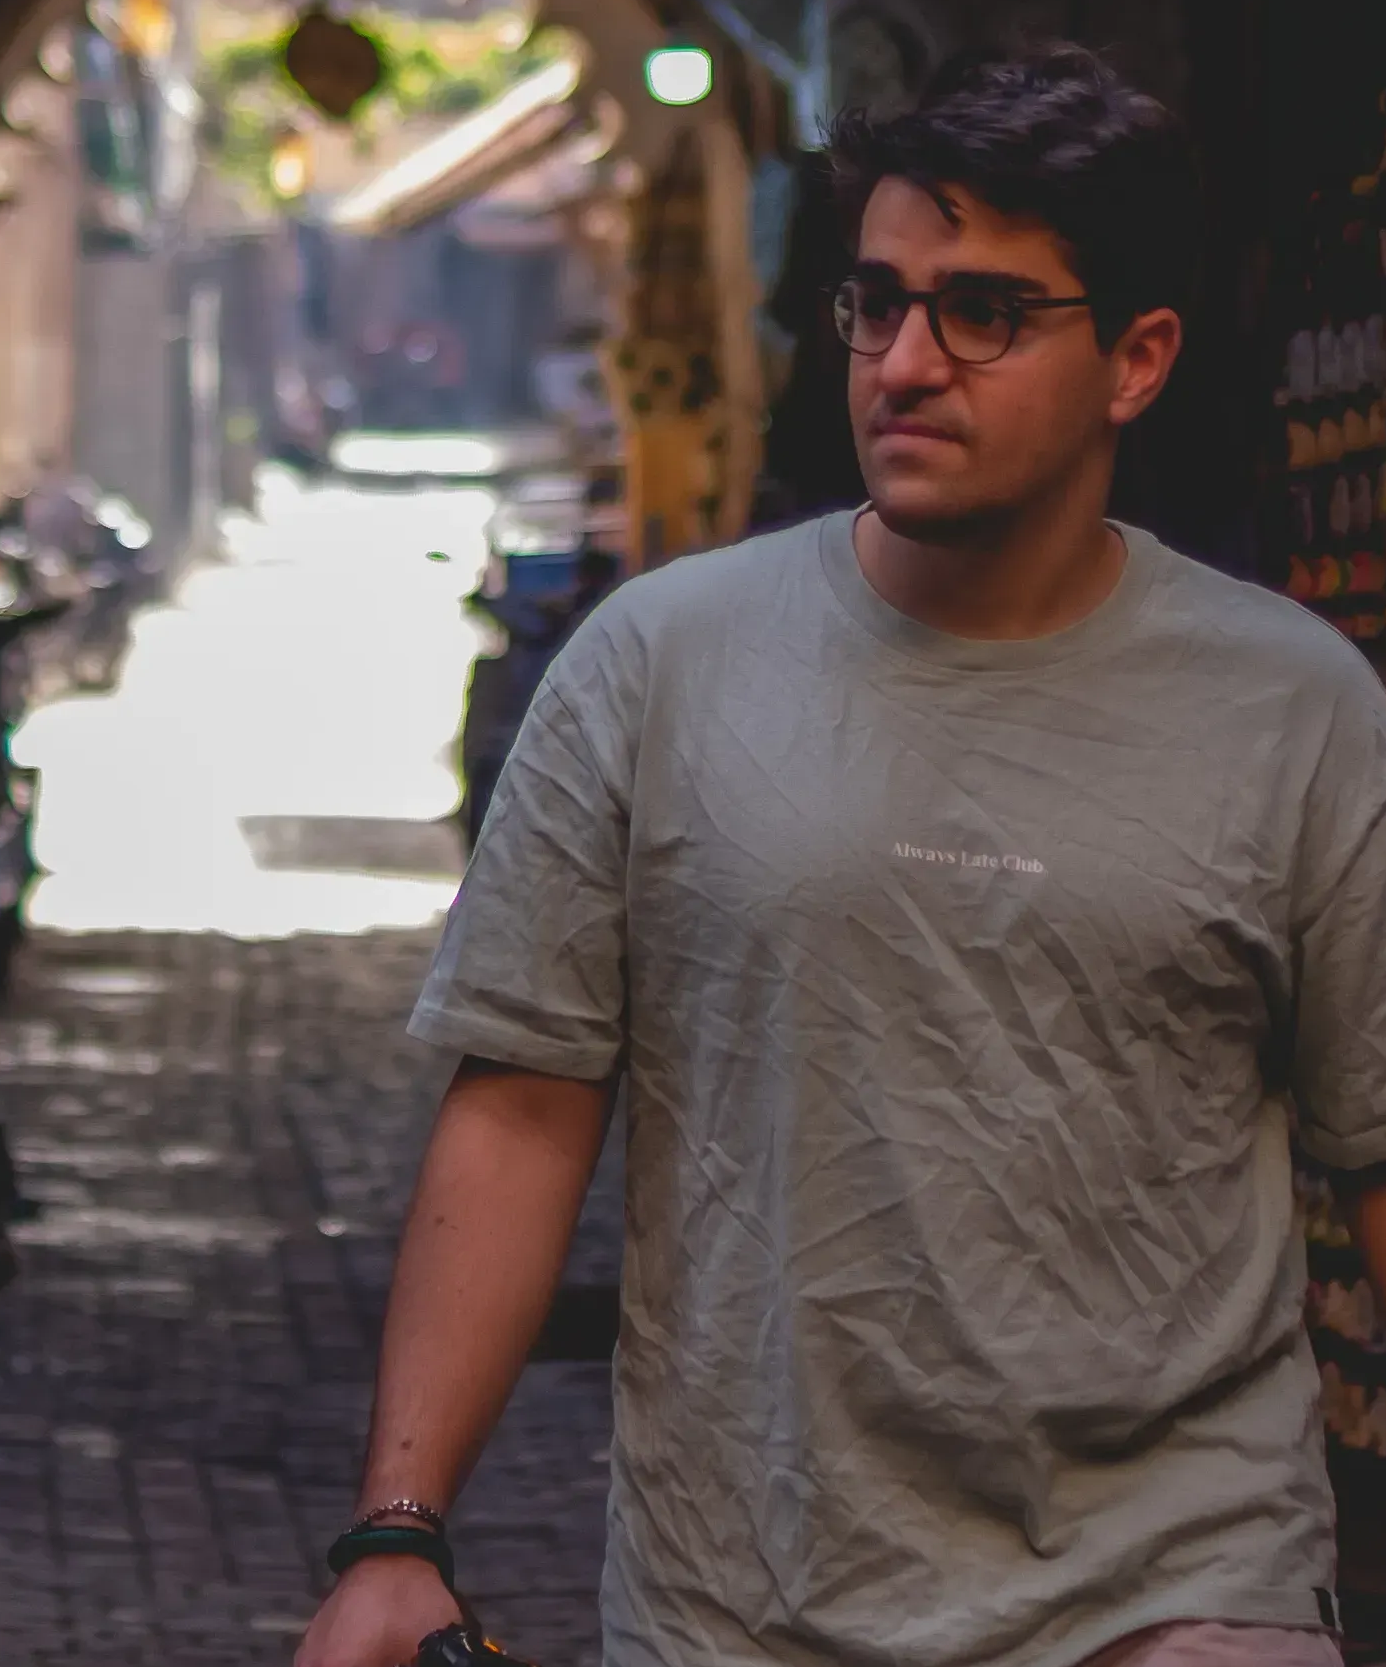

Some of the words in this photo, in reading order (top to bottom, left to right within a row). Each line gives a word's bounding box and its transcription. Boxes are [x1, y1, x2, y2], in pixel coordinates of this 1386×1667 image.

[891, 841, 956, 865] Always
[961, 850, 998, 869] Late
[1002, 854, 1045, 874] Club
